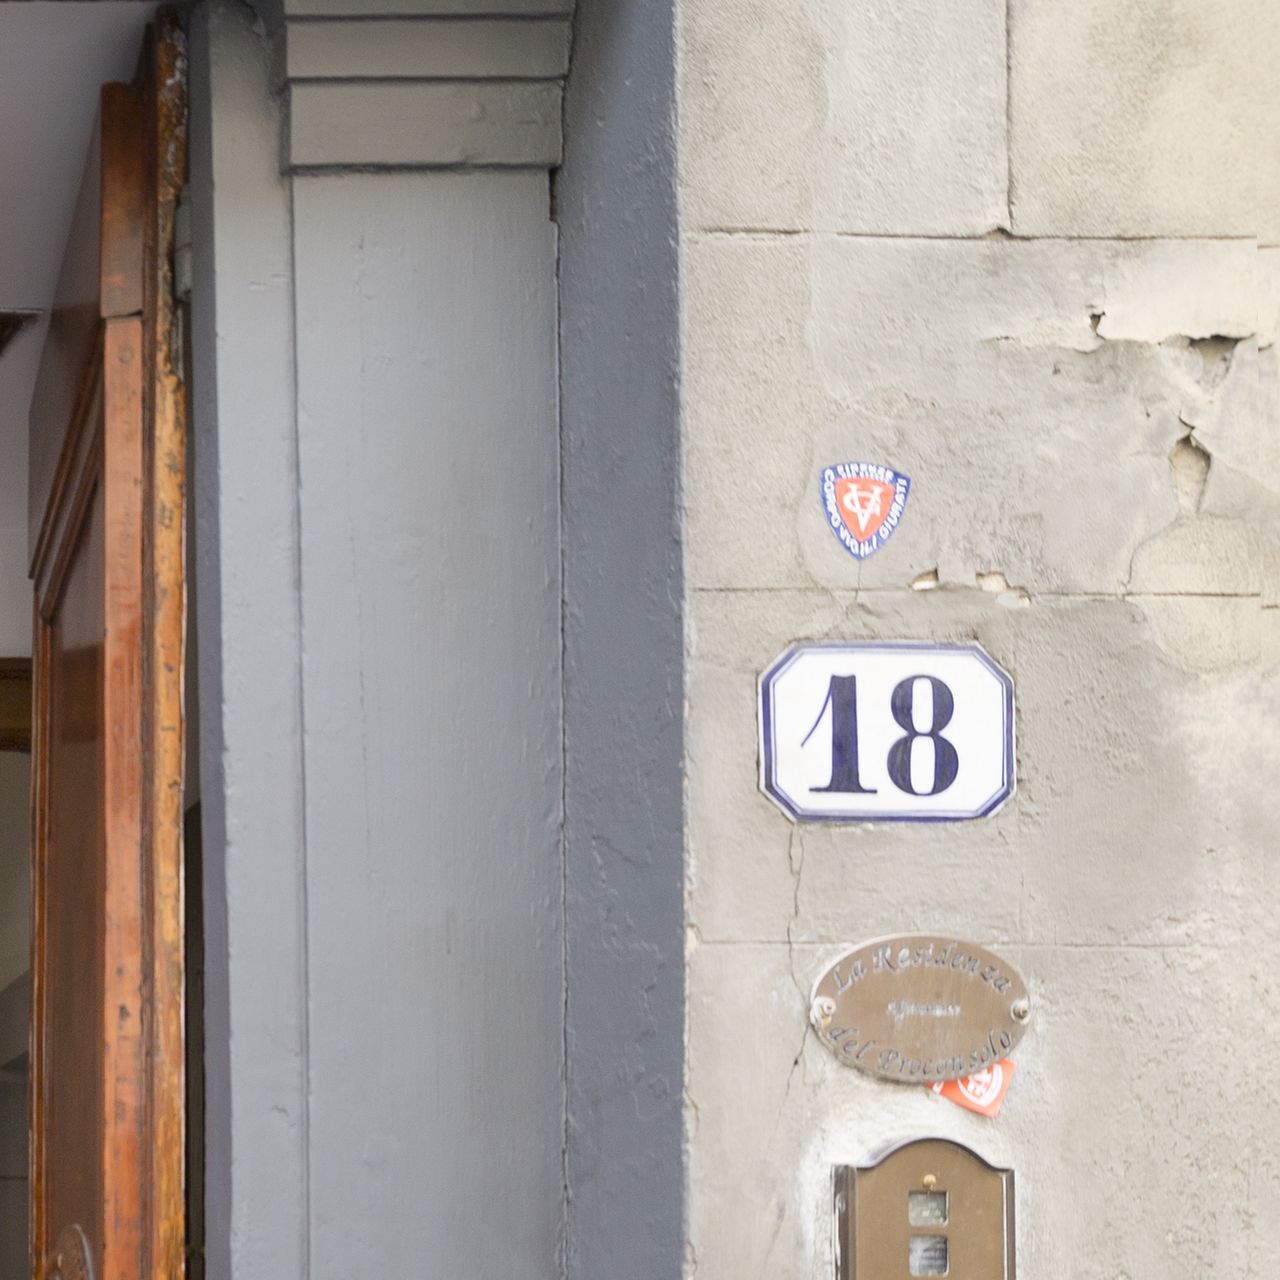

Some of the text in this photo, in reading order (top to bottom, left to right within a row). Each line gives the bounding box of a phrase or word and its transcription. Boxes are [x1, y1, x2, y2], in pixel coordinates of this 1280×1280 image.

[840, 524, 878, 557] VIGILI
[879, 478, 908, 540] GIURATI
[800, 674, 959, 796] 18
[832, 943, 1013, 994] La Residenza
[827, 1026, 1013, 1077] del Proconsolo
